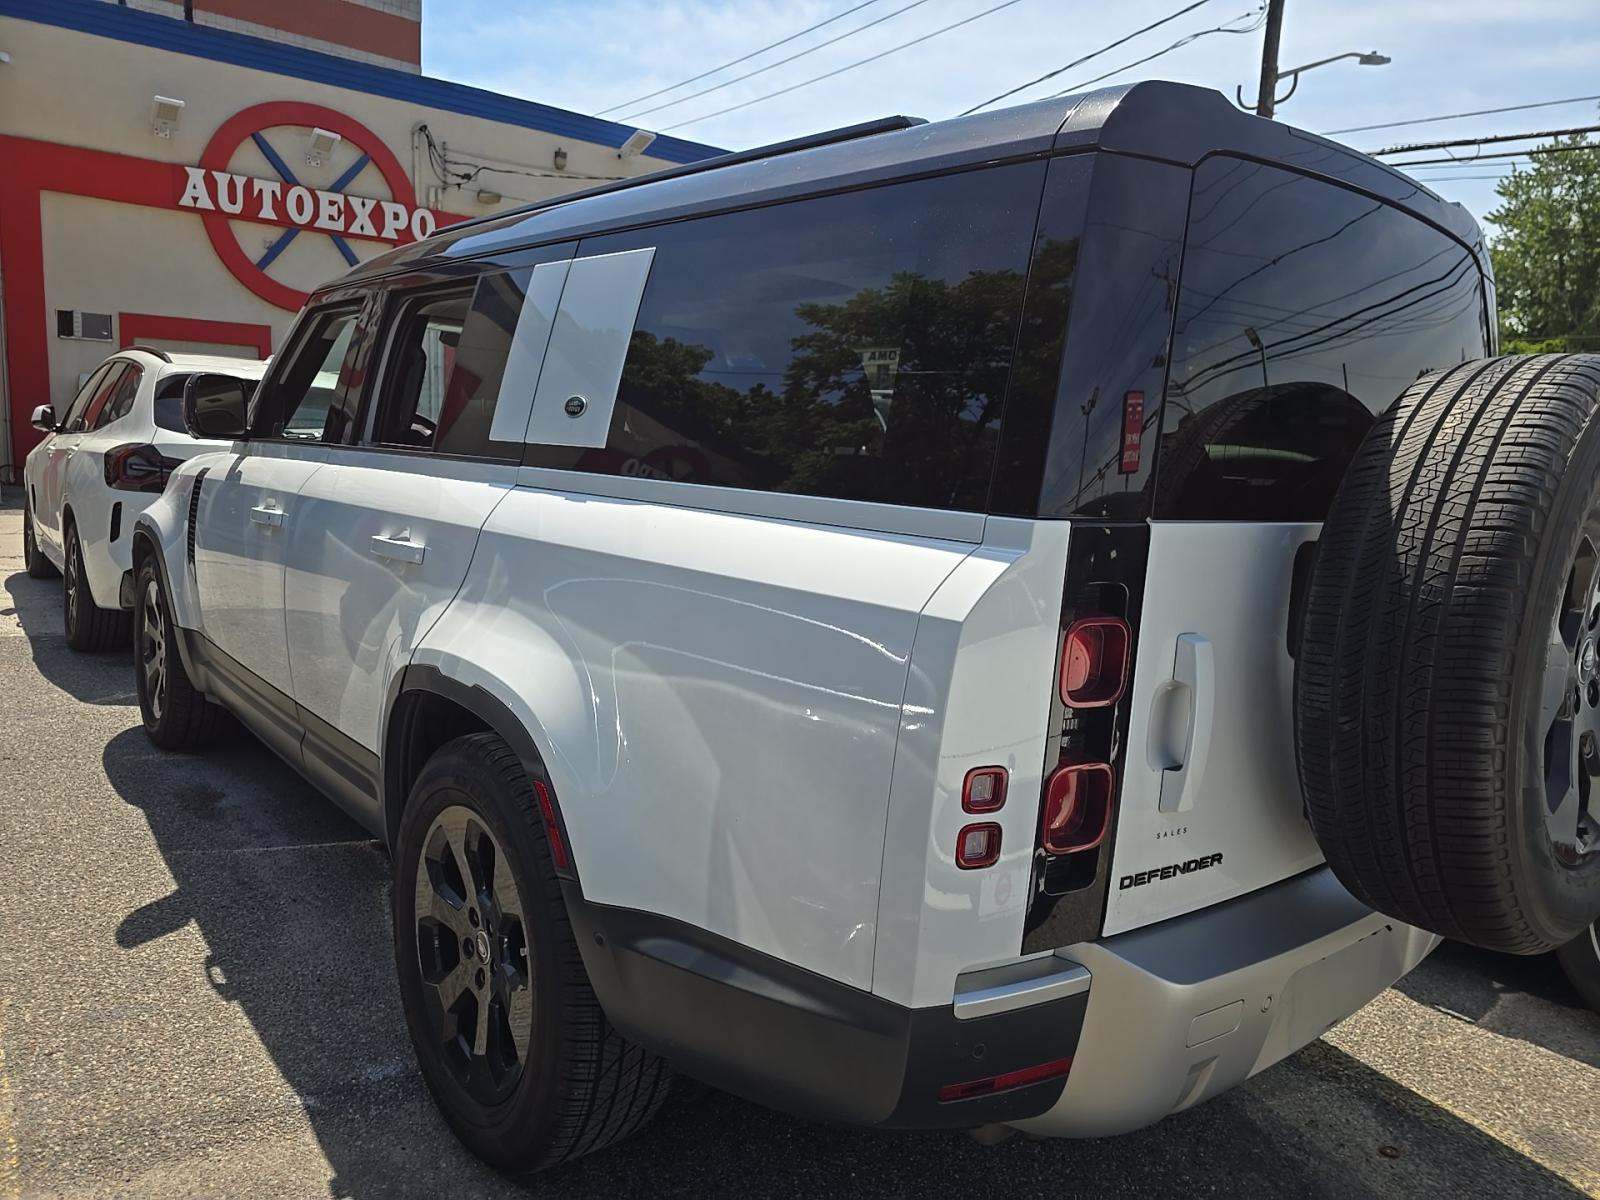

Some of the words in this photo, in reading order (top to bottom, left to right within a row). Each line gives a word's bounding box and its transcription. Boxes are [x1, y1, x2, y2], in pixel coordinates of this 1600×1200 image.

[178, 166, 436, 241] AUTOEXPO
[1156, 827, 1188, 839] SALES
[1119, 852, 1224, 890] DEFENDER
